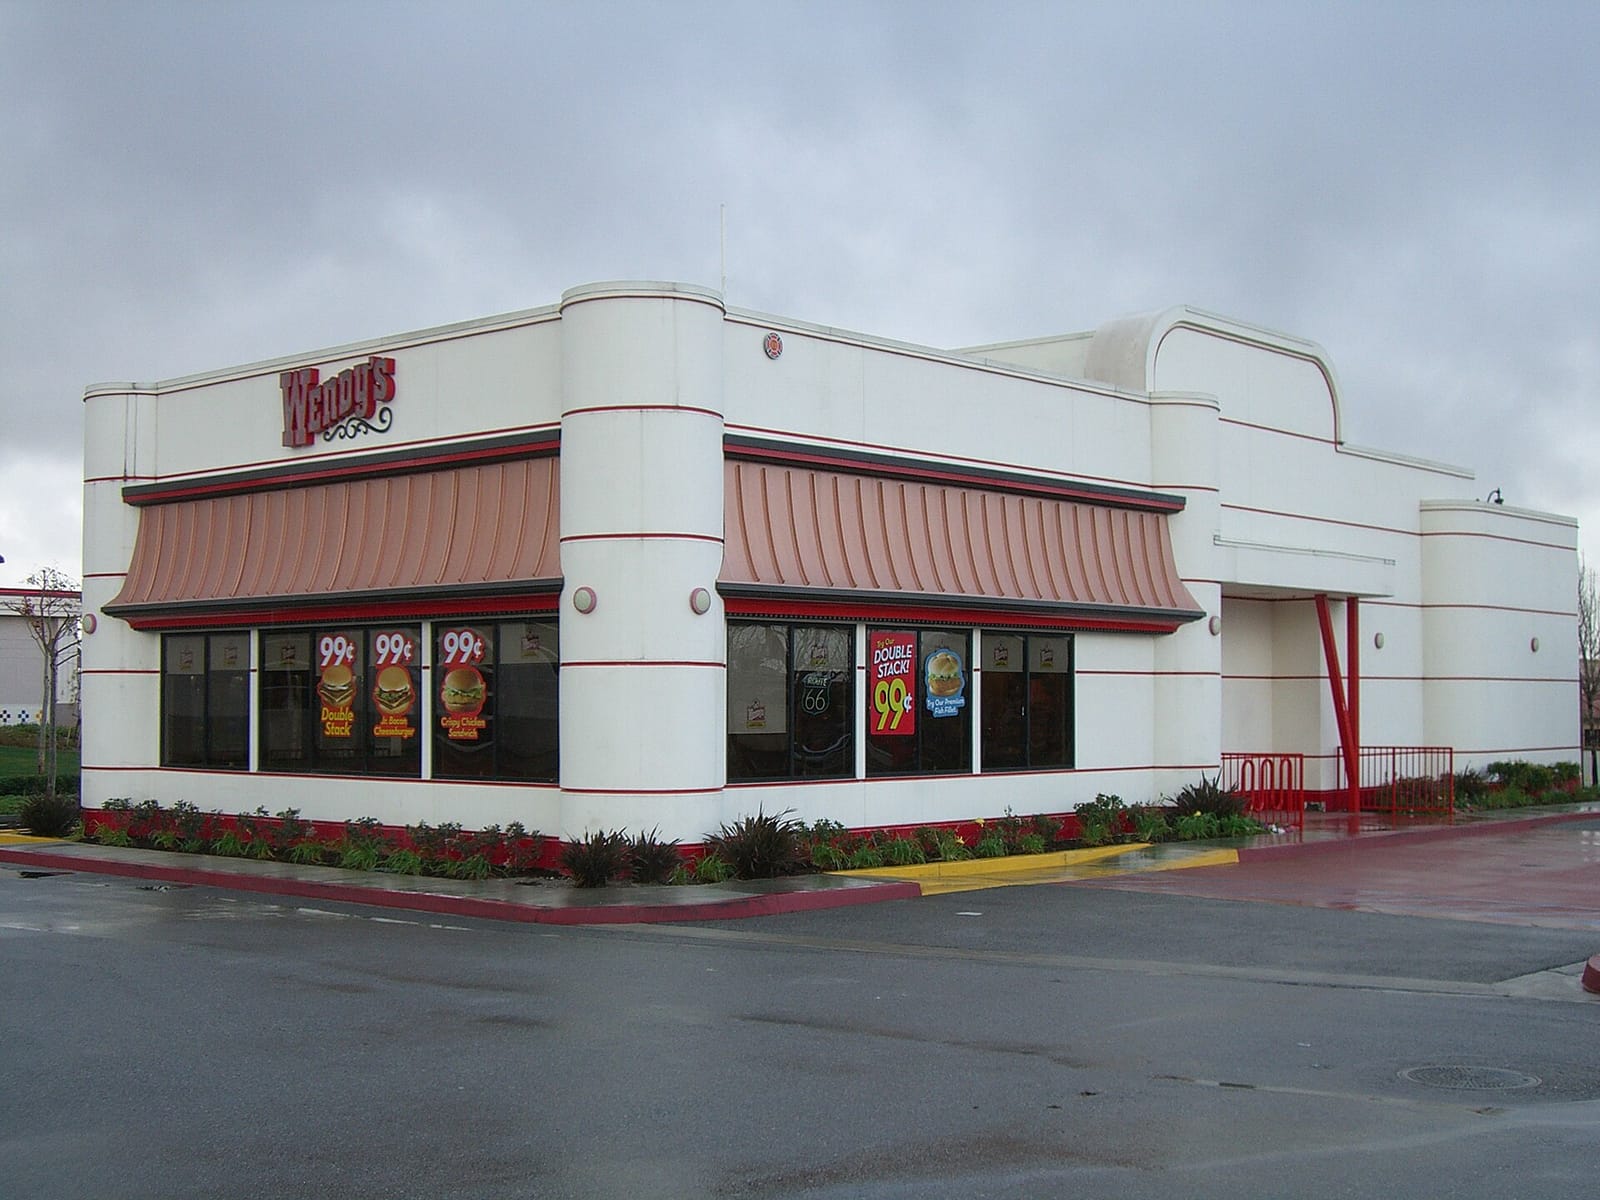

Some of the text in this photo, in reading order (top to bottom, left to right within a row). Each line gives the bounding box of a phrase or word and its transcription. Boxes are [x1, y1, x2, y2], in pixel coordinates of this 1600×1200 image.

[280, 356, 395, 448] Wendy's
[376, 633, 412, 665] 99¢
[443, 631, 482, 664] 99¢
[876, 638, 895, 648] Try Our
[320, 636, 354, 667] 99¢
[874, 644, 913, 664] DOUBLE
[877, 660, 910, 679] STACK!
[807, 676, 828, 687] ROUTE
[805, 689, 826, 710] 66
[874, 677, 913, 731] 99¢
[927, 700, 935, 708] Try
[321, 707, 354, 721] Double
[390, 716, 408, 725] Bacon
[325, 721, 352, 736] Stack
[441, 717, 486, 728] Crispy Chicken
[373, 726, 415, 738] Cheeseburger
[448, 728, 478, 738] Sandwich
